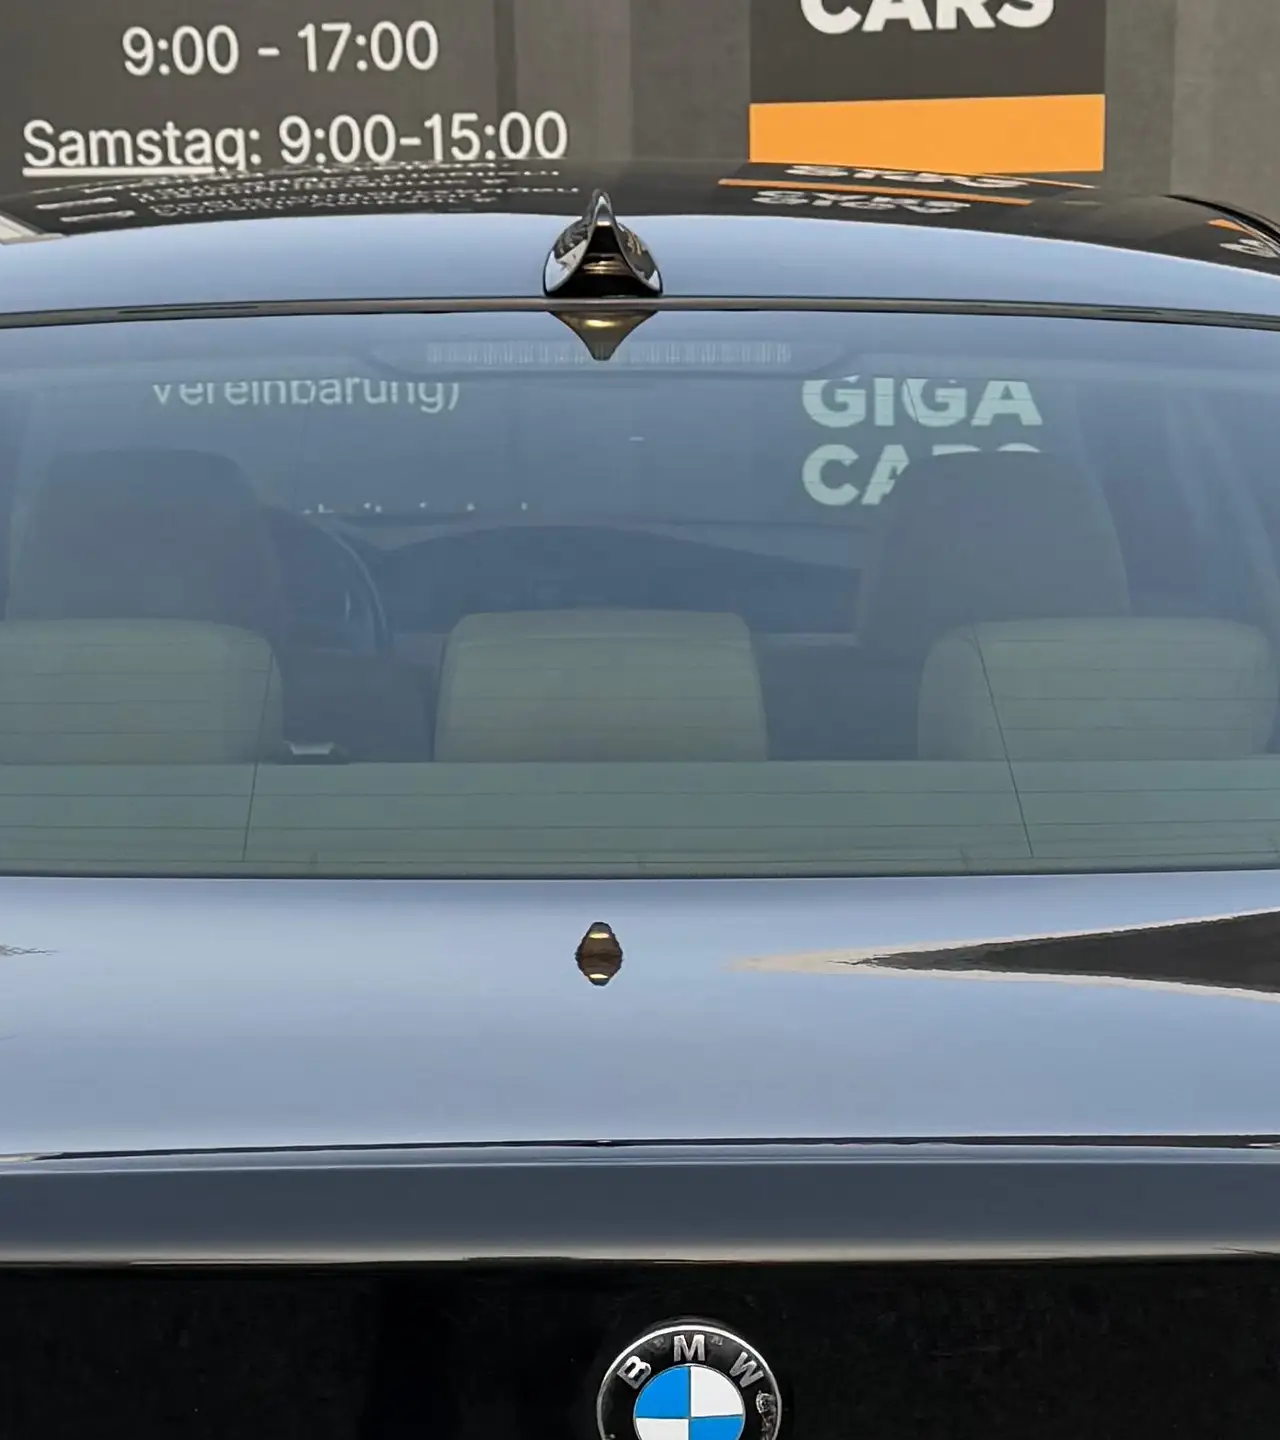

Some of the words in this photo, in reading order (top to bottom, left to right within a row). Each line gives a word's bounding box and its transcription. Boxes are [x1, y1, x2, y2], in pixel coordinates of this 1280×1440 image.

[122, 24, 239, 76] 9:00
[257, 47, 280, 56] -
[297, 20, 439, 72] 17:00
[278, 110, 568, 163] 9:00-15:00
[802, 375, 1043, 428] GIGA
[617, 1334, 764, 1390] BMW
